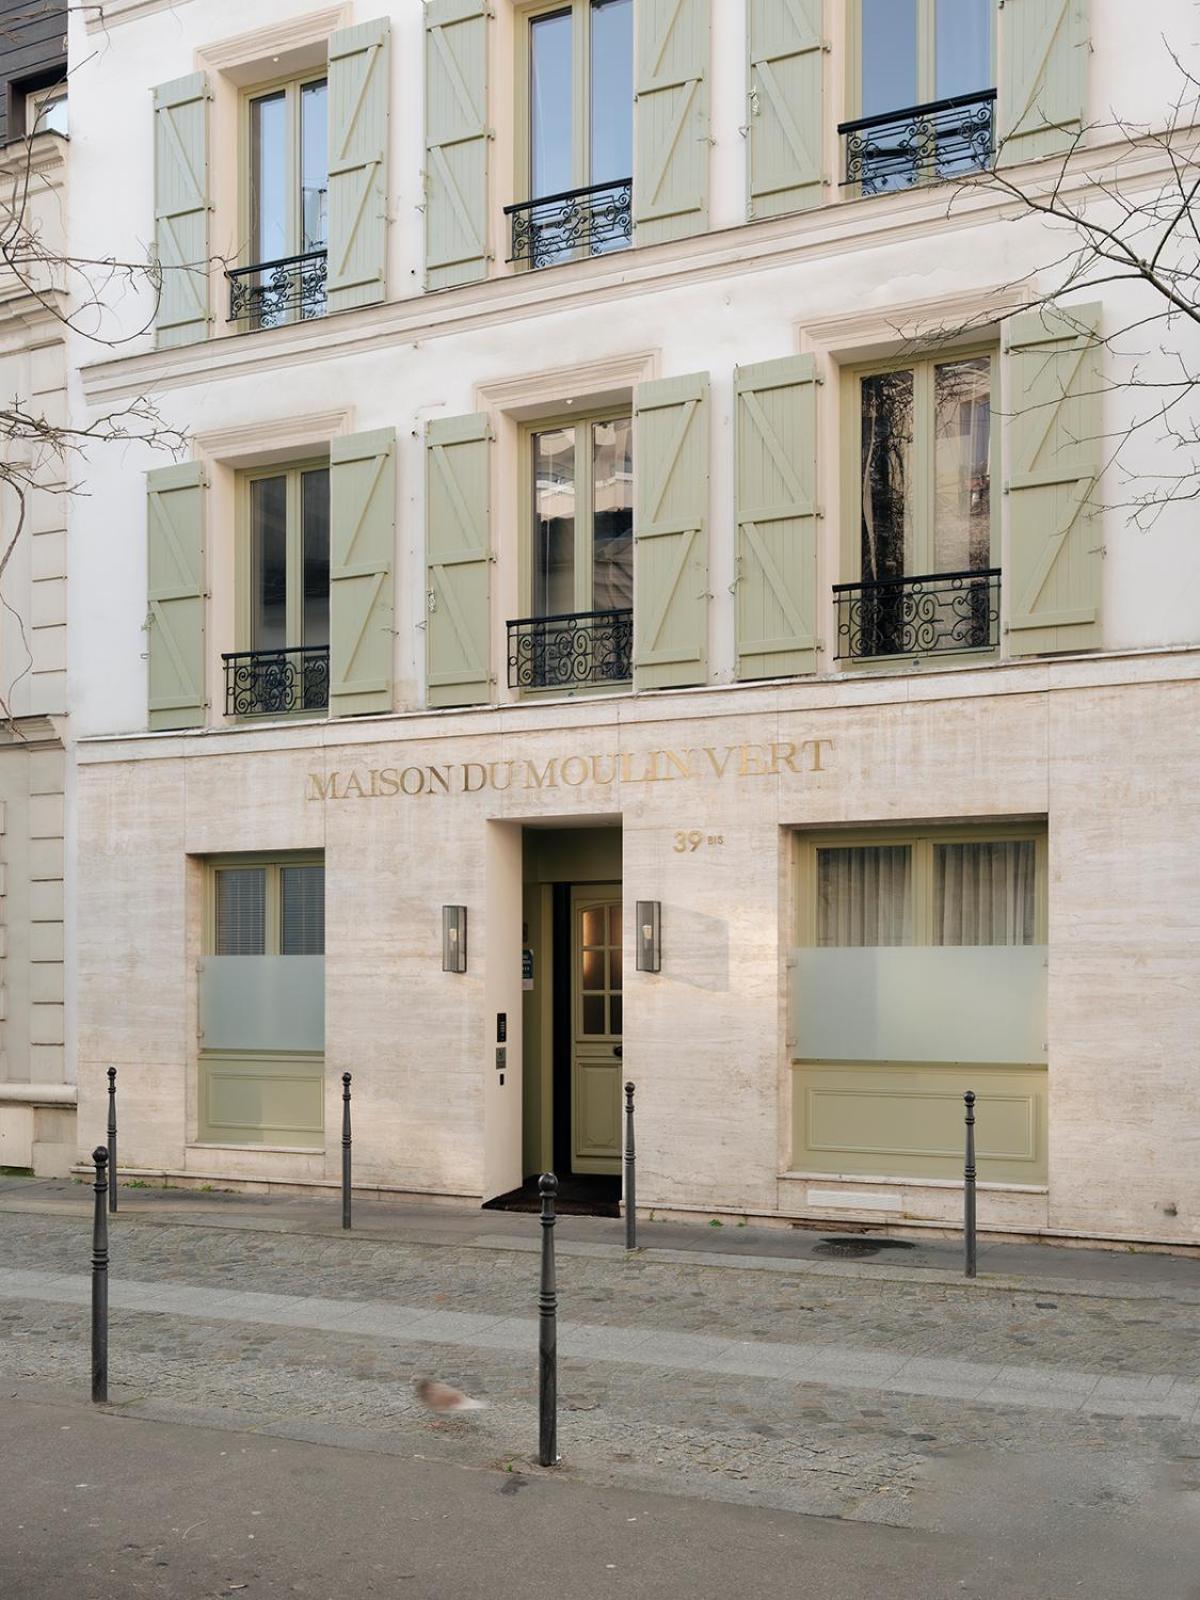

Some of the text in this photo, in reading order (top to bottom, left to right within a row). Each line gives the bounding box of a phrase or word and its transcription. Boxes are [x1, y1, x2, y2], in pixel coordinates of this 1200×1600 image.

[307, 739, 834, 801] MAISON DU MOULIN VERT
[672, 830, 724, 853] 39 BIS
